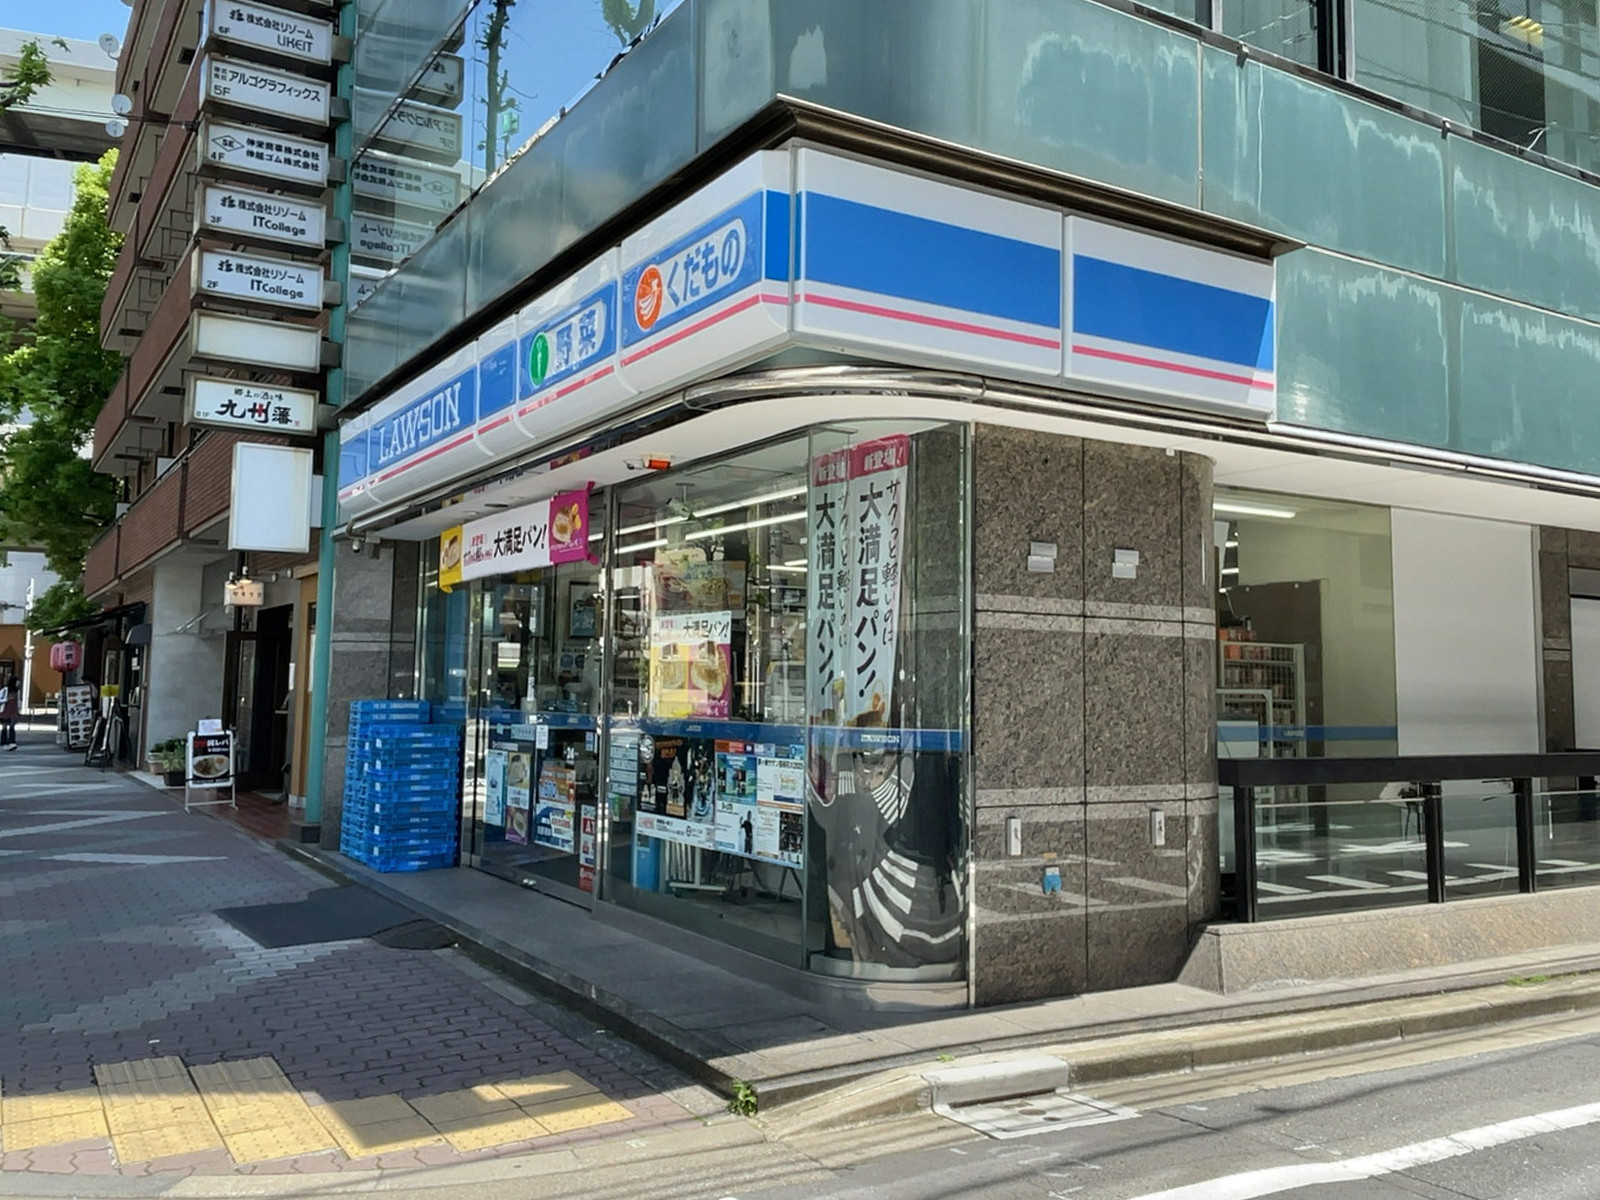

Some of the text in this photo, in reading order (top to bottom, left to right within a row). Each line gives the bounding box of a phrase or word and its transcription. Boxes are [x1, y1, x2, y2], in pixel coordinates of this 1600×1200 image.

[246, 13, 314, 40] 株式会社リゾーム
[214, 84, 231, 96] 5F
[228, 69, 321, 102] アルゴグラフィックス
[210, 151, 225, 161] 4F
[221, 138, 235, 148] SE
[238, 199, 307, 222] 株式会社リゾーム
[253, 215, 306, 237] ITCollege
[235, 262, 304, 284] 株式会社リゾーム
[667, 228, 741, 307] くだもの
[206, 280, 219, 289] 2F
[250, 279, 304, 300] ITCollege
[556, 309, 597, 369] 野菜
[214, 399, 293, 425] 九州藩
[378, 381, 461, 465] LAWSON
[493, 523, 547, 559] 大満足パン!
[881, 478, 901, 646] サクっと軽いのに
[815, 492, 836, 696] 大満足パン!
[854, 481, 883, 699] 大満足パン!
